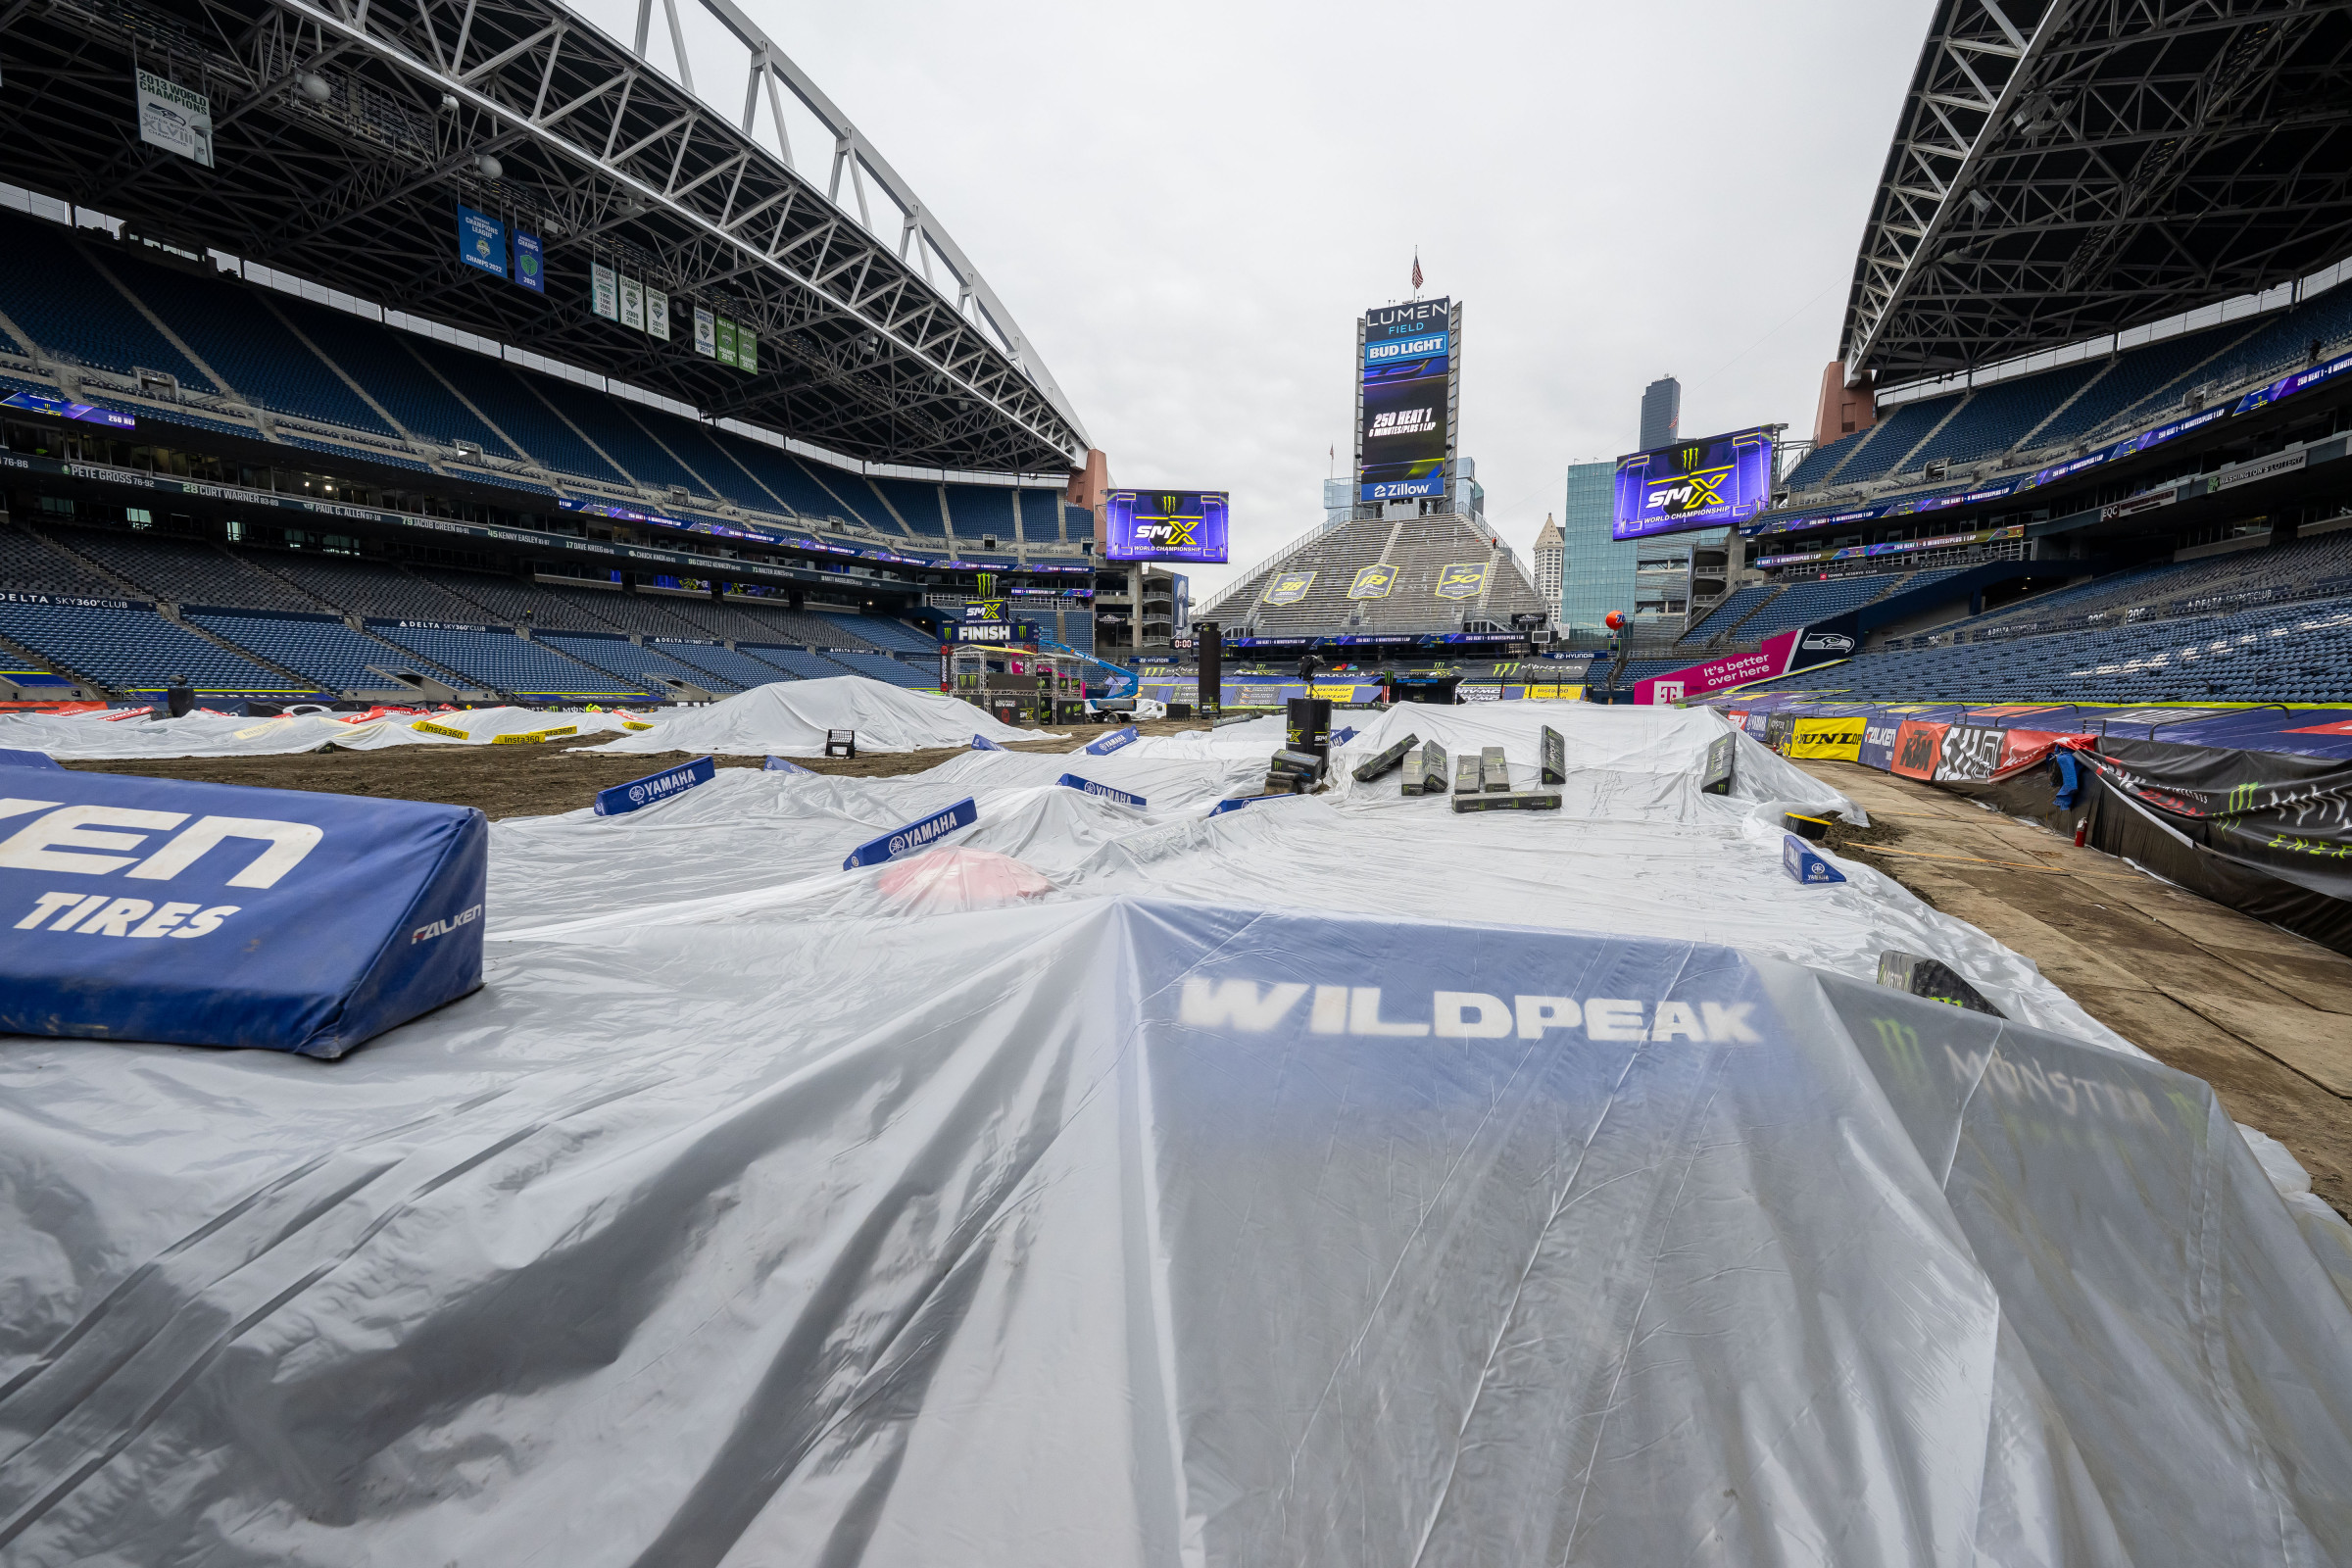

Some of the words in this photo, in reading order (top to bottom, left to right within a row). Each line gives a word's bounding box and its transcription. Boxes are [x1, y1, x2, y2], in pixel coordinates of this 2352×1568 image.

[139, 72, 168, 90] 2013
[170, 83, 207, 107] WORLD
[139, 80, 208, 116] CHAMPIONS
[141, 117, 193, 145] XLVIII
[148, 128, 188, 147] CHAMPIONS
[465, 217, 499, 235] CHAMPIONS
[471, 225, 493, 239] LEAGUE
[517, 238, 539, 252] CHAMPS
[466, 254, 489, 268] CHAMPS
[489, 263, 503, 273] 2022
[523, 276, 536, 286] 2025
[626, 309, 639, 319] 2009
[626, 316, 639, 326] 2010
[696, 314, 713, 325] SHIELD
[1366, 301, 1448, 327] LUMEN
[653, 319, 664, 329] 2011
[1389, 321, 1424, 335] FIELD
[696, 338, 714, 351] CHAMPS
[700, 345, 711, 354] 2014
[718, 346, 736, 358] CHAMPS
[1369, 344, 1399, 360] BUD
[1400, 337, 1444, 355] LIGHT
[2297, 375, 2308, 386] 250
[1373, 412, 1396, 428] 250
[1396, 408, 1425, 425] HEAT
[1425, 407, 1433, 422] 1
[1374, 423, 1419, 437] MINUTES/PLUS
[1423, 421, 1436, 431] LAP
[3, 457, 28, 469] 76-86
[2220, 466, 2270, 485] WASHINGTON'S
[2271, 456, 2303, 470] LOTTERY
[72, 466, 97, 479] PETE
[98, 470, 132, 485] GROSS
[133, 477, 155, 488] 76-92
[182, 483, 199, 494] 28
[199, 486, 222, 498] CURT
[223, 490, 260, 504] WARNER
[1387, 482, 1430, 497] Zillow
[1645, 472, 1730, 510] SMX
[316, 504, 334, 515] PAUL
[344, 509, 366, 519] ALLEN
[1643, 514, 1670, 524] WORLD
[1670, 506, 1731, 520] CHAMPIONSHIP
[2102, 505, 2118, 517] EQC
[402, 516, 414, 526] 79
[413, 518, 434, 529] JACOB
[434, 521, 456, 532] GREEN
[487, 529, 498, 538] 45
[498, 531, 516, 541] KENNY
[517, 534, 538, 544] EASLEY
[1135, 520, 1200, 545] SMX
[573, 542, 587, 552] DAVE
[587, 544, 604, 554] KRIEG
[636, 551, 653, 560] CHUCK
[653, 553, 666, 562] KNOX
[712, 562, 731, 570] KENNEDY
[1274, 581, 1307, 592] 38
[1357, 574, 1389, 588] 18
[1443, 573, 1482, 585] 30
[966, 603, 1002, 619] SMX
[1616, 613, 1627, 623] 76
[409, 620, 440, 629] DELTA
[958, 625, 1010, 641] FINISH
[1174, 639, 1192, 649] 0:00
[1703, 662, 1725, 677] It's
[1726, 654, 1770, 671] better
[1707, 673, 1739, 687] over
[1739, 664, 1770, 679] here
[349, 710, 374, 722] FLY
[425, 723, 464, 739] Insta360
[1864, 727, 1895, 747] FALKEN
[504, 735, 539, 744] Insta360
[1104, 735, 1127, 750] YAMAHA
[1899, 729, 1933, 771] KTM
[644, 767, 697, 796] YAMAHA
[1095, 784, 1133, 805] YAMAHA
[905, 810, 958, 848] YAMAHA
[14, 890, 242, 939] TIRES
[411, 904, 483, 945] FALKEN
[1179, 978, 1764, 1044] WILDPEAK
